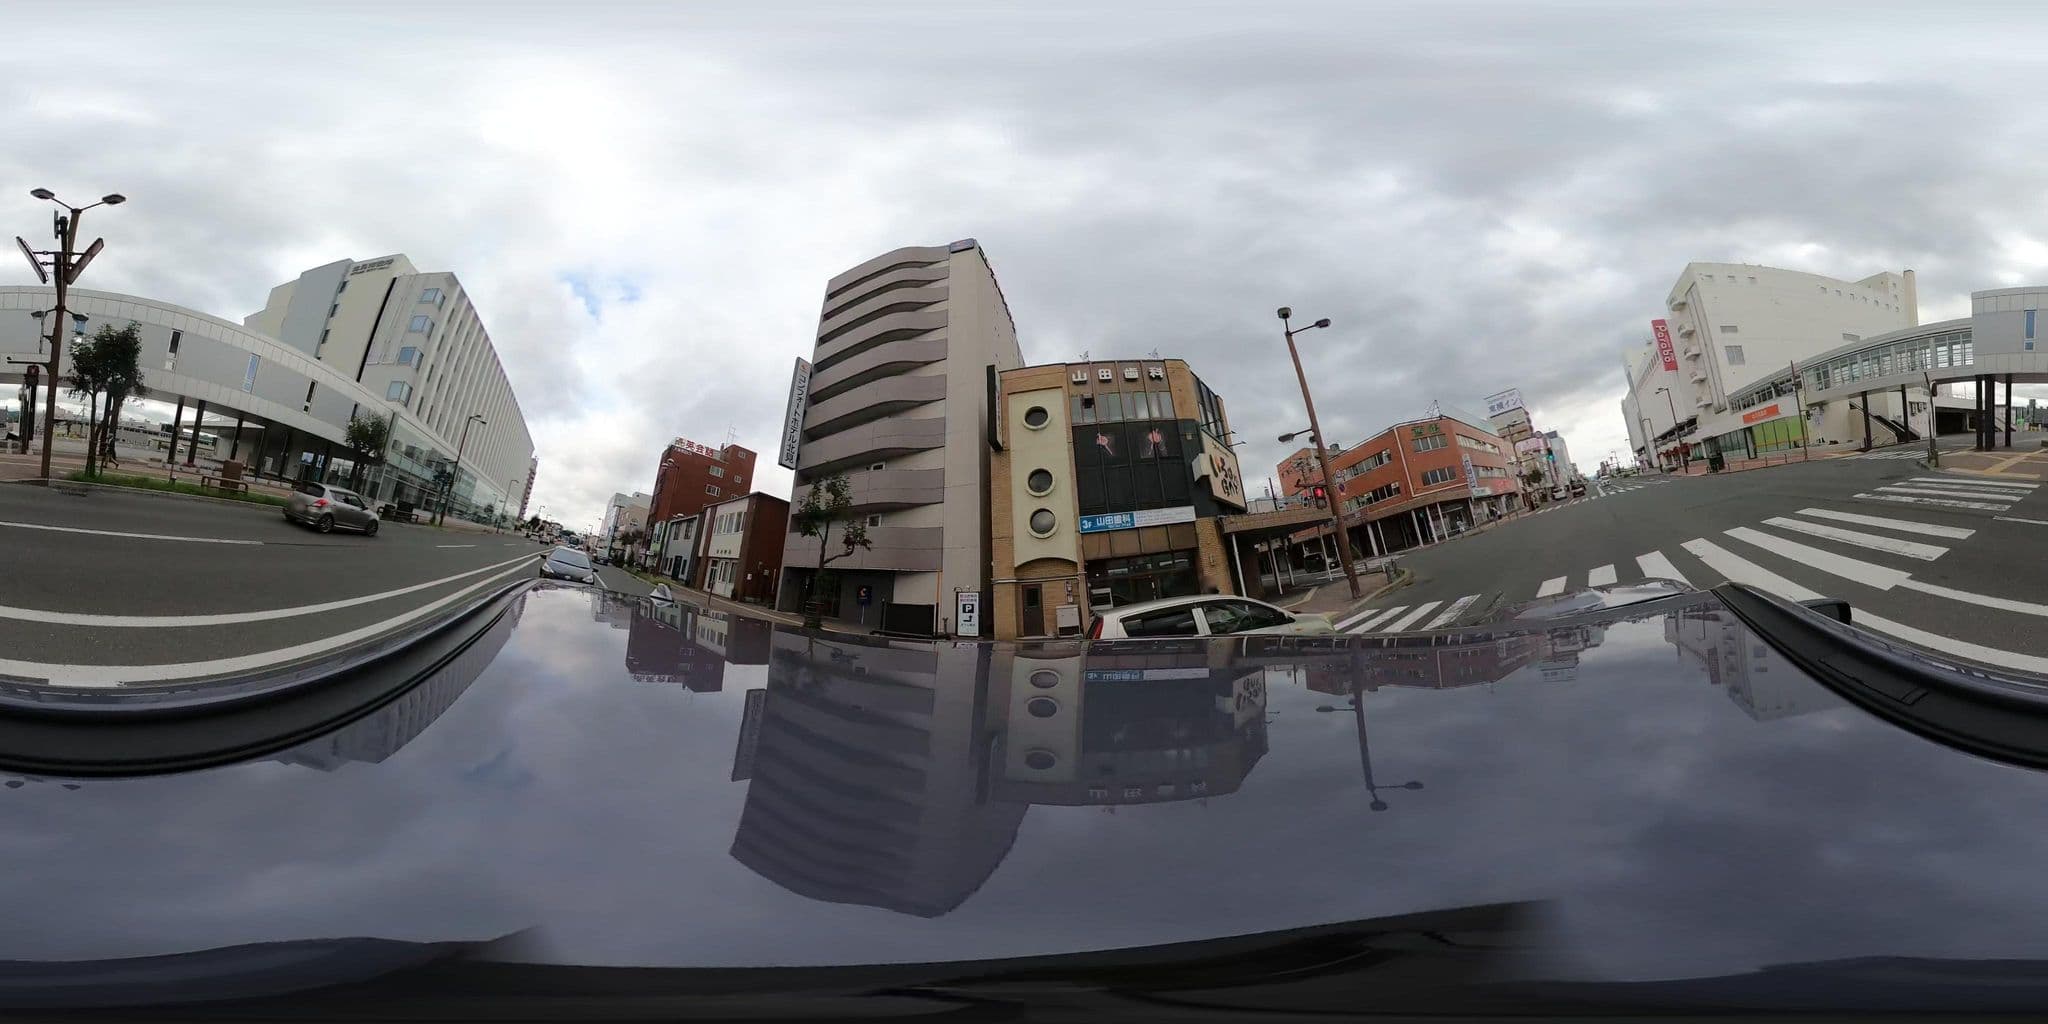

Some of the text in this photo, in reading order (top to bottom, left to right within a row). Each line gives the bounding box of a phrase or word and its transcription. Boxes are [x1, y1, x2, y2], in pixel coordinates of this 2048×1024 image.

[1655, 325, 1673, 363] Parabo
[1072, 367, 1163, 382] 山田歯科
[785, 374, 807, 464] コンフォートホテル北見
[1082, 520, 1092, 529] 3F
[1096, 514, 1131, 526] 山田歯科
